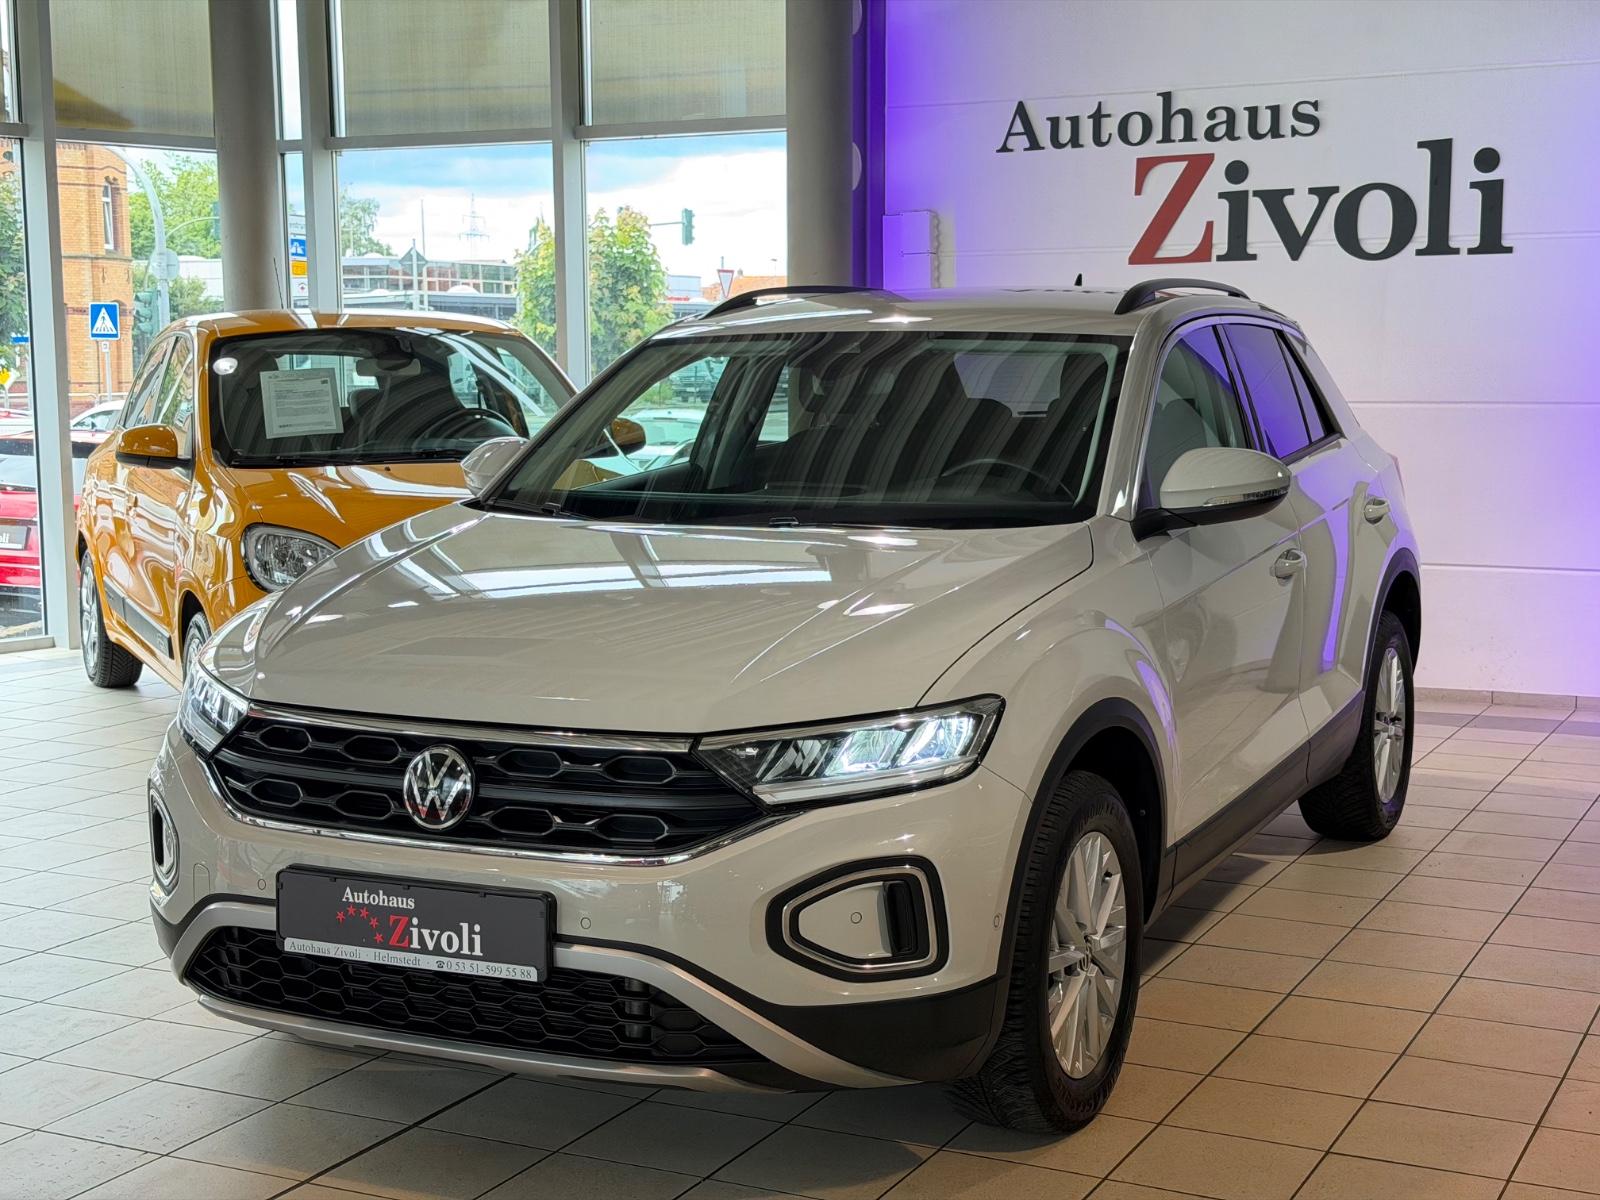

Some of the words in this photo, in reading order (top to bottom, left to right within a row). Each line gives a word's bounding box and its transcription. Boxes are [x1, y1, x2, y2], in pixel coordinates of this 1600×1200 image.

[996, 91, 1320, 153] Autohaus
[1128, 138, 1514, 265] Zivoli
[342, 887, 415, 909] Autohaus
[289, 941, 331, 955] Autohaus
[334, 946, 361, 959] Zivoli
[373, 951, 421, 967] Helmstedt
[388, 915, 483, 956] Zivoli
